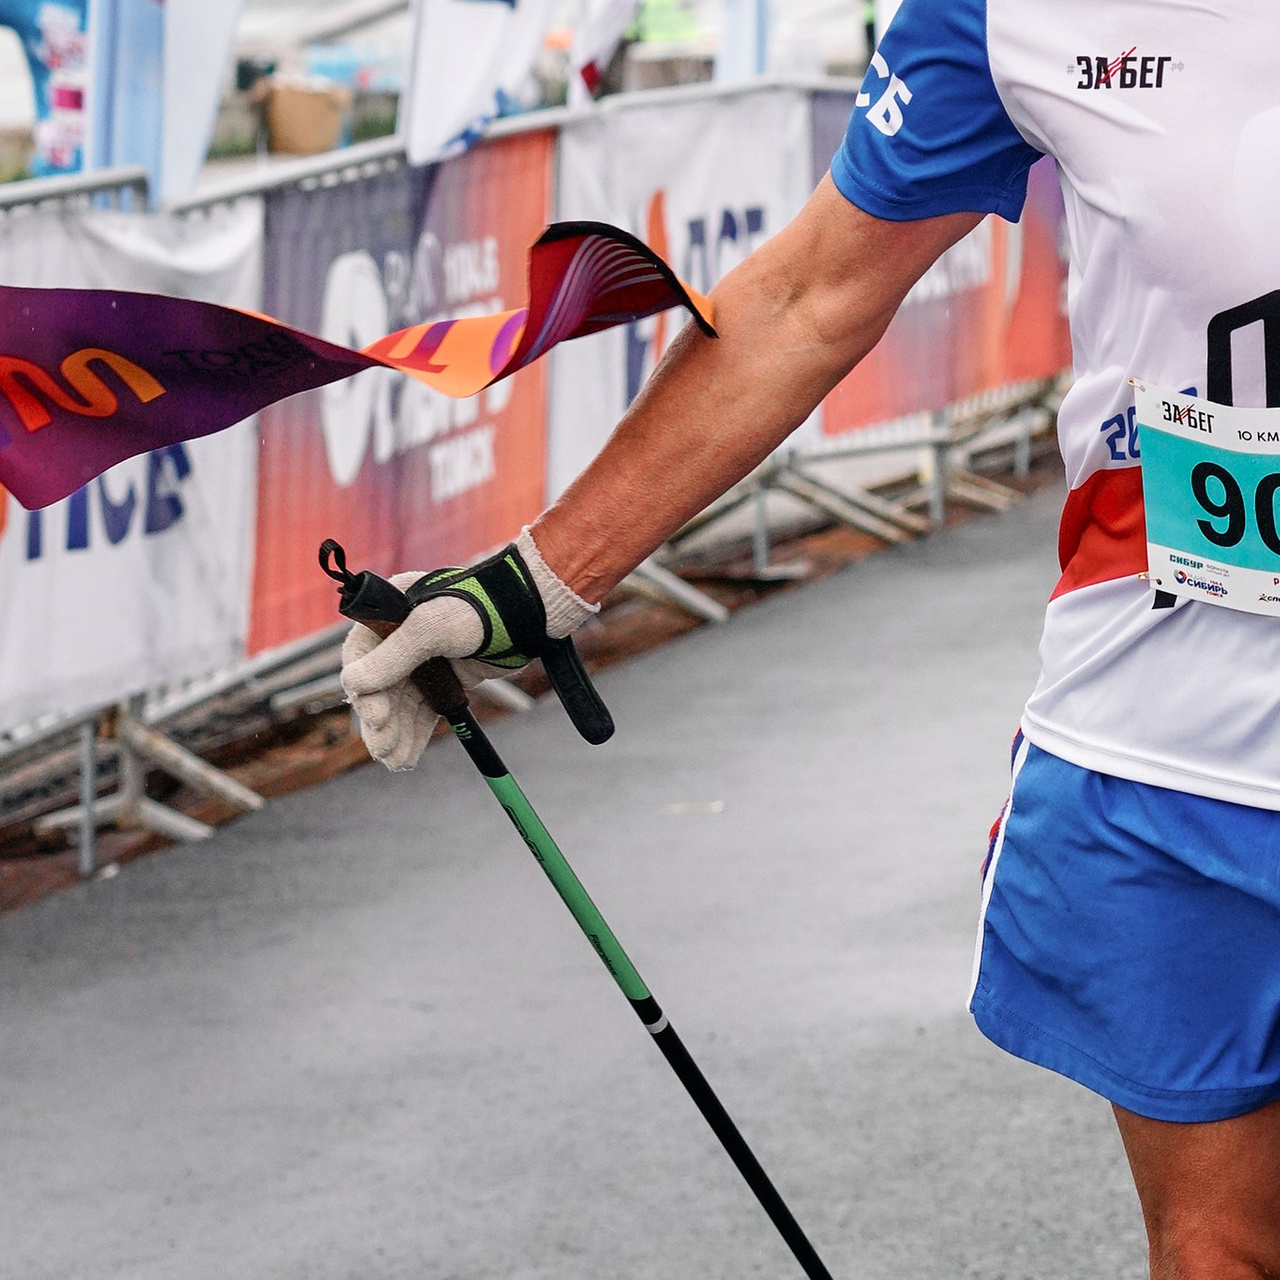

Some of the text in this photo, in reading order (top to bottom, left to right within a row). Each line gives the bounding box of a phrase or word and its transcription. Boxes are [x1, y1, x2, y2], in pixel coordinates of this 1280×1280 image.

[1237, 430, 1253, 441] 10
[1169, 554, 1204, 570] СИБУР
[1186, 578, 1229, 595] СИБИРЬ
